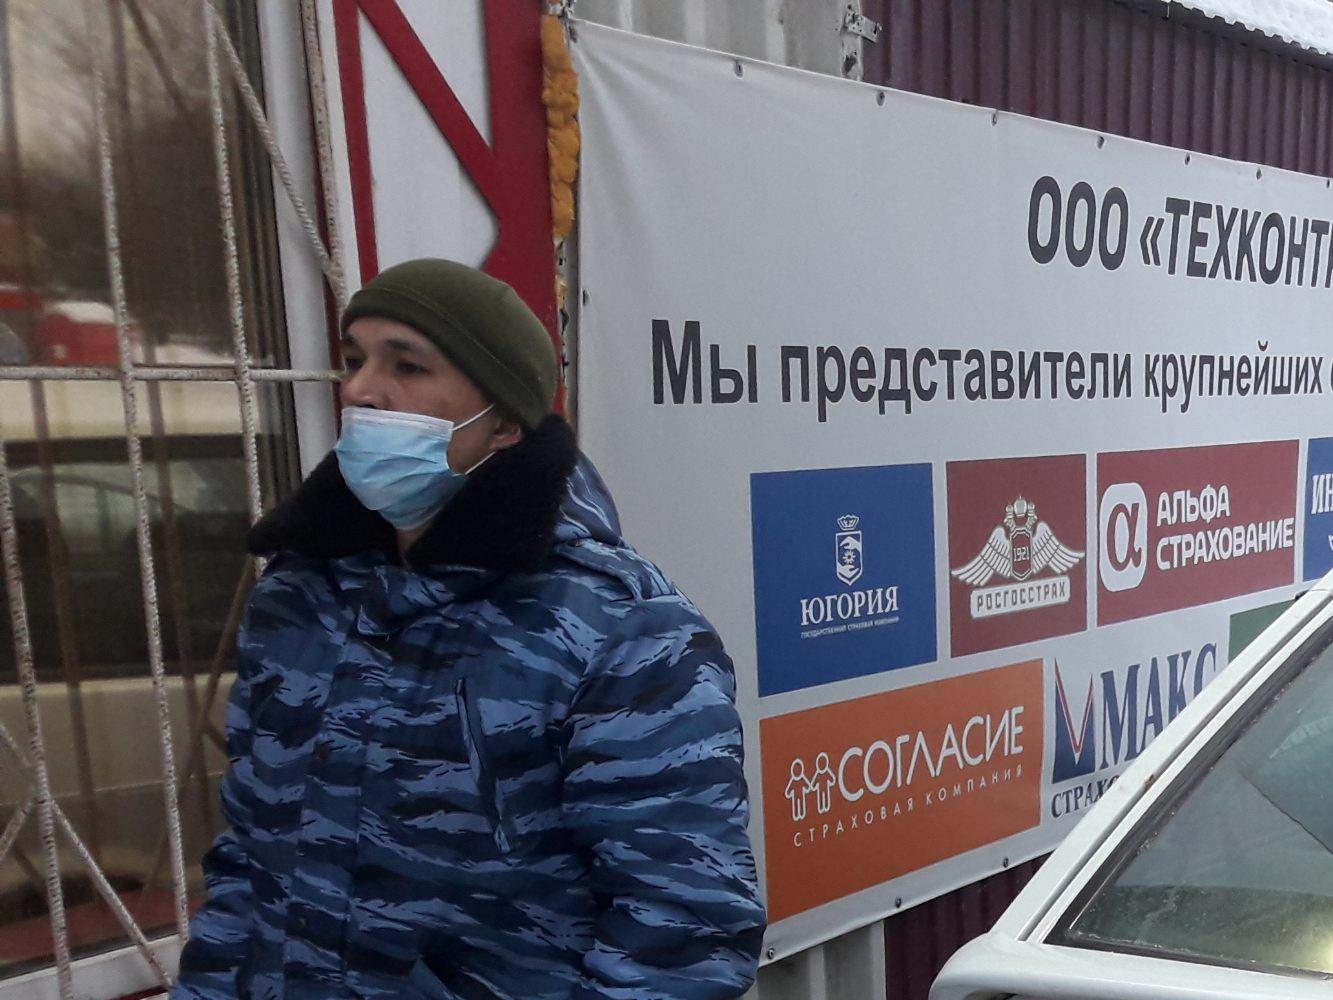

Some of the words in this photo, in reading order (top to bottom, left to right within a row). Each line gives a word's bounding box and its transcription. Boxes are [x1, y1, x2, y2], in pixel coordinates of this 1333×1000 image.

[1027, 176, 1129, 270] ООО
[651, 319, 758, 404] Мы
[780, 345, 1132, 422] представители
[1144, 340, 1323, 413] крупнейших
[1156, 484, 1231, 527] АЛЬФА
[1013, 546, 1030, 562] 1921
[1156, 517, 1295, 571] СТРАХОВАНИЕ
[800, 586, 899, 626] ЮГОРИЯ
[976, 581, 1066, 612] РОСГОССТРАХ
[838, 705, 1024, 802] СОГЛАСИЕ
[793, 797, 915, 847] СТРАХОВАЯ
[925, 764, 1023, 806] КОМПАНИЯ
